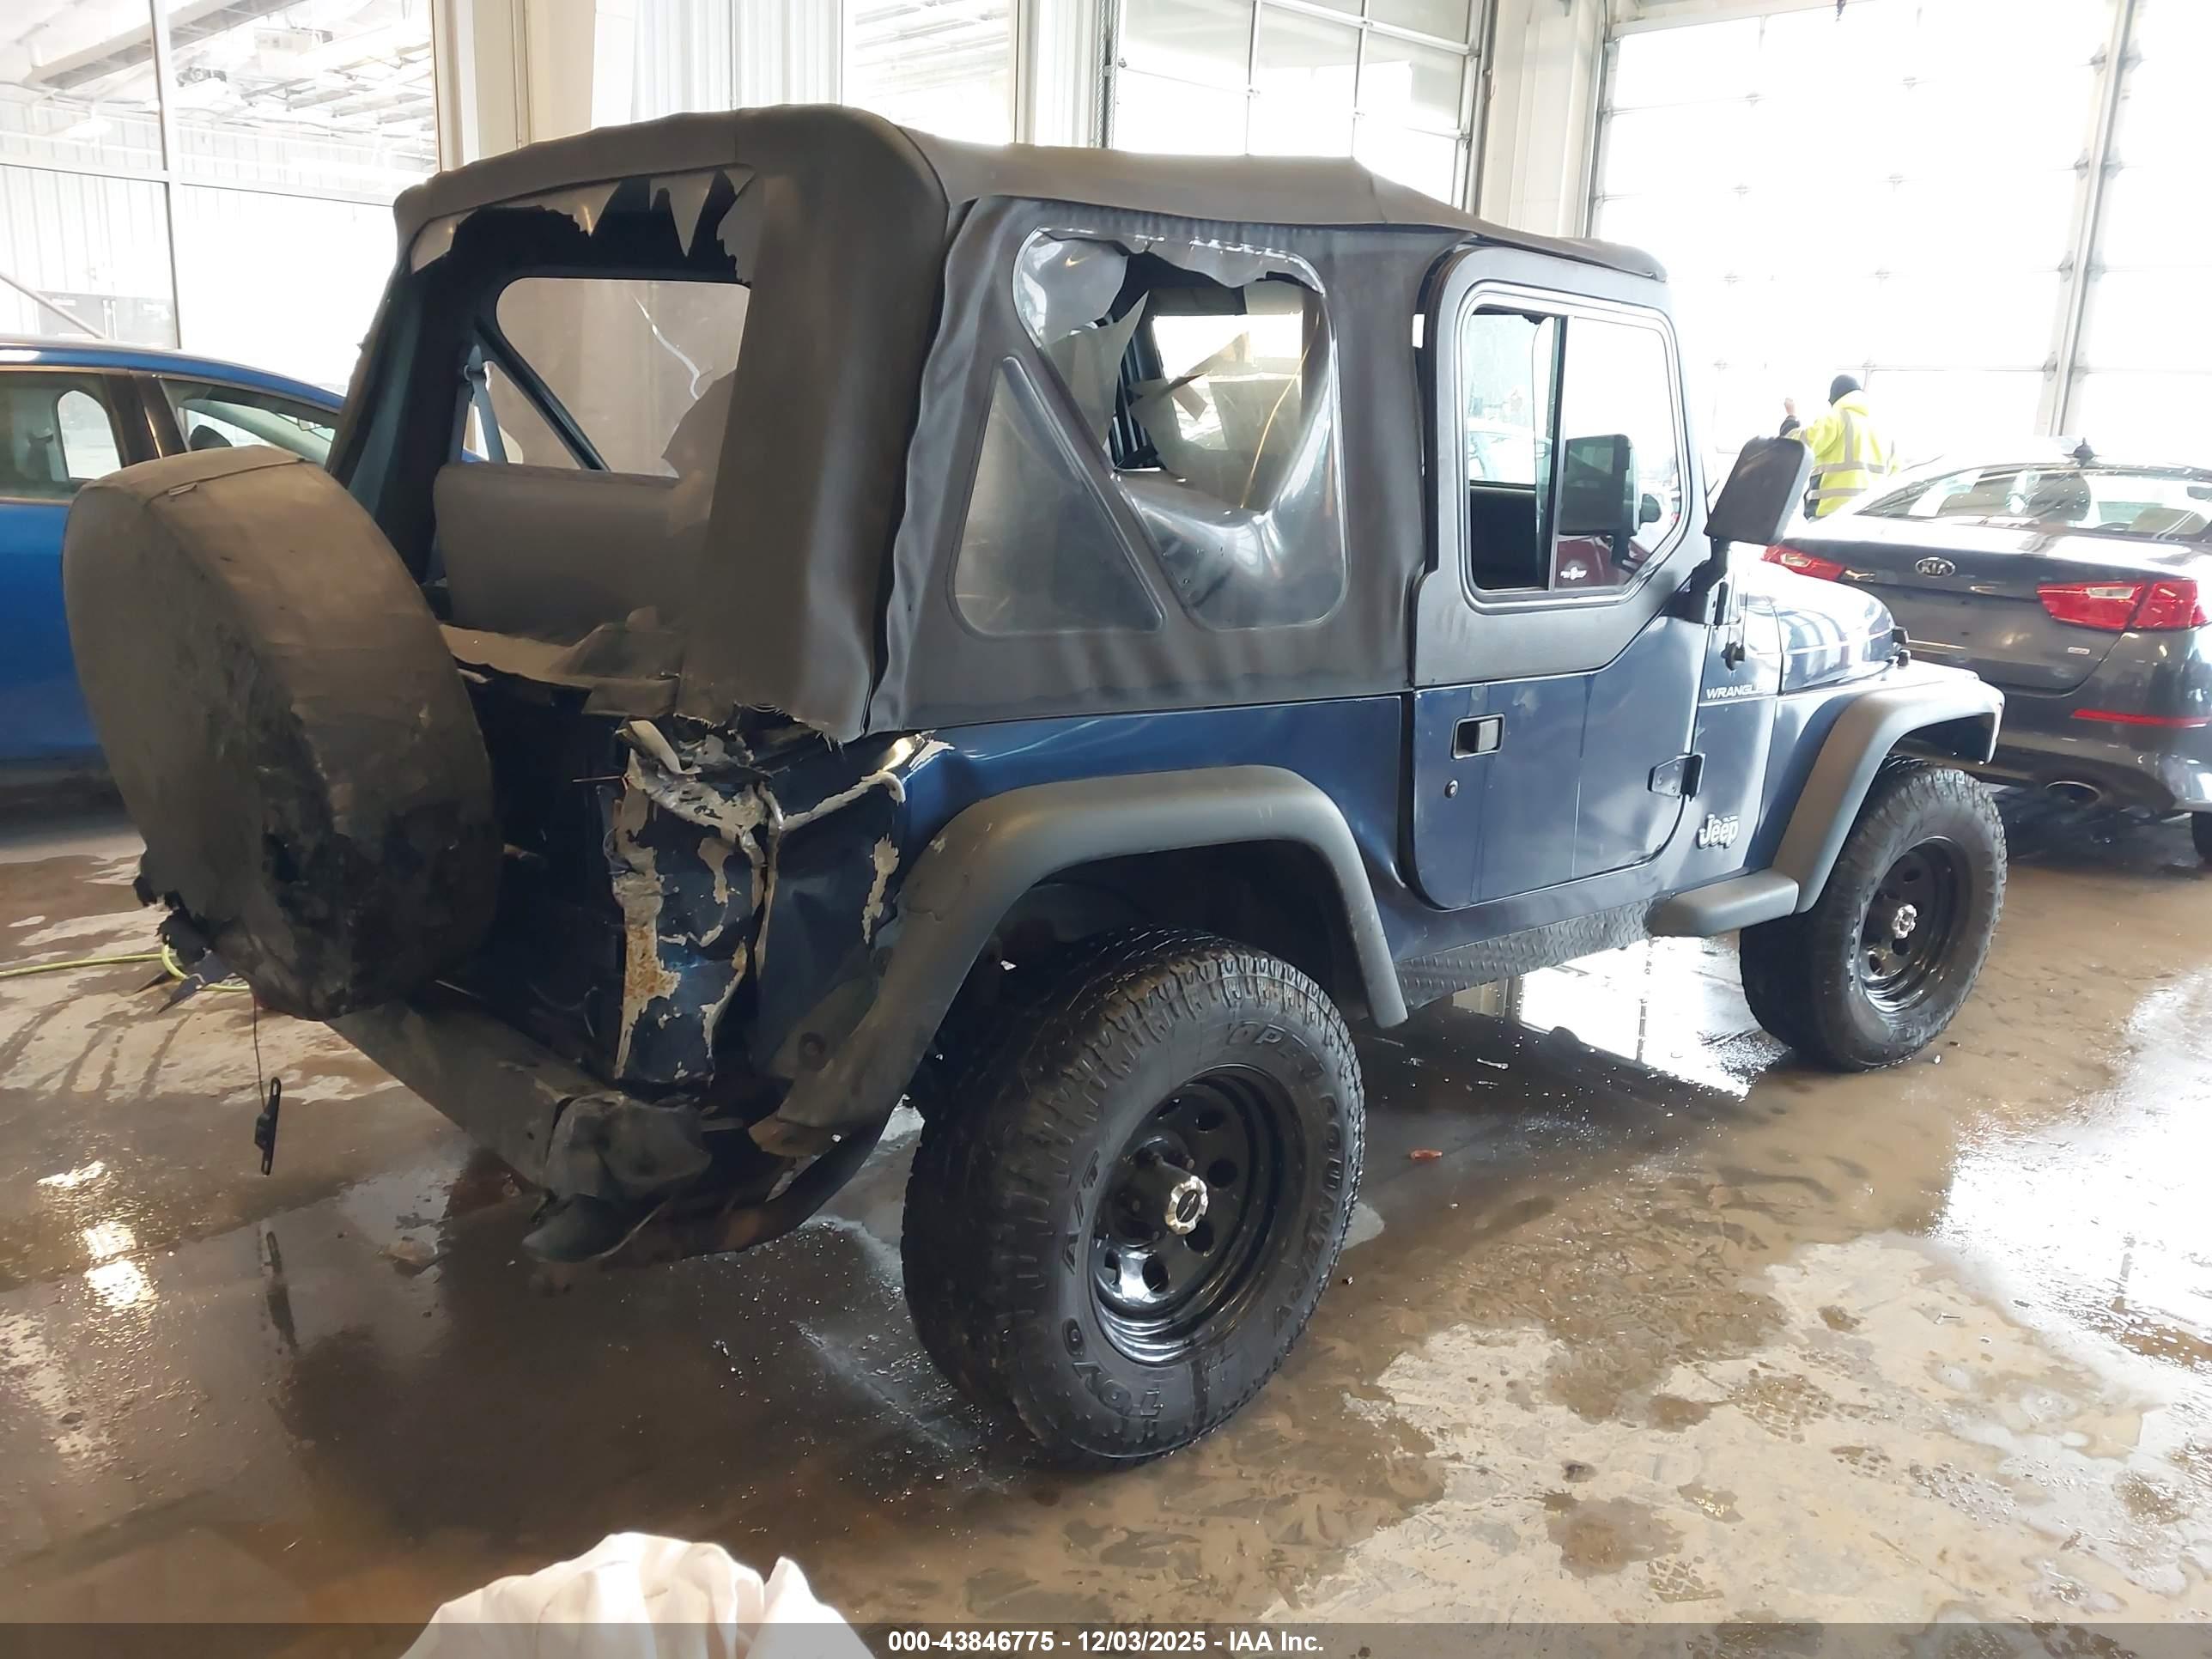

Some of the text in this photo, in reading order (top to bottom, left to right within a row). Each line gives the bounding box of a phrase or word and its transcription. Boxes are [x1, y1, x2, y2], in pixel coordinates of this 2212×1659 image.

[1918, 562, 1951, 576] KIA
[1706, 684, 1771, 699] WRANGLE
[1698, 813, 1739, 848] Jeep
